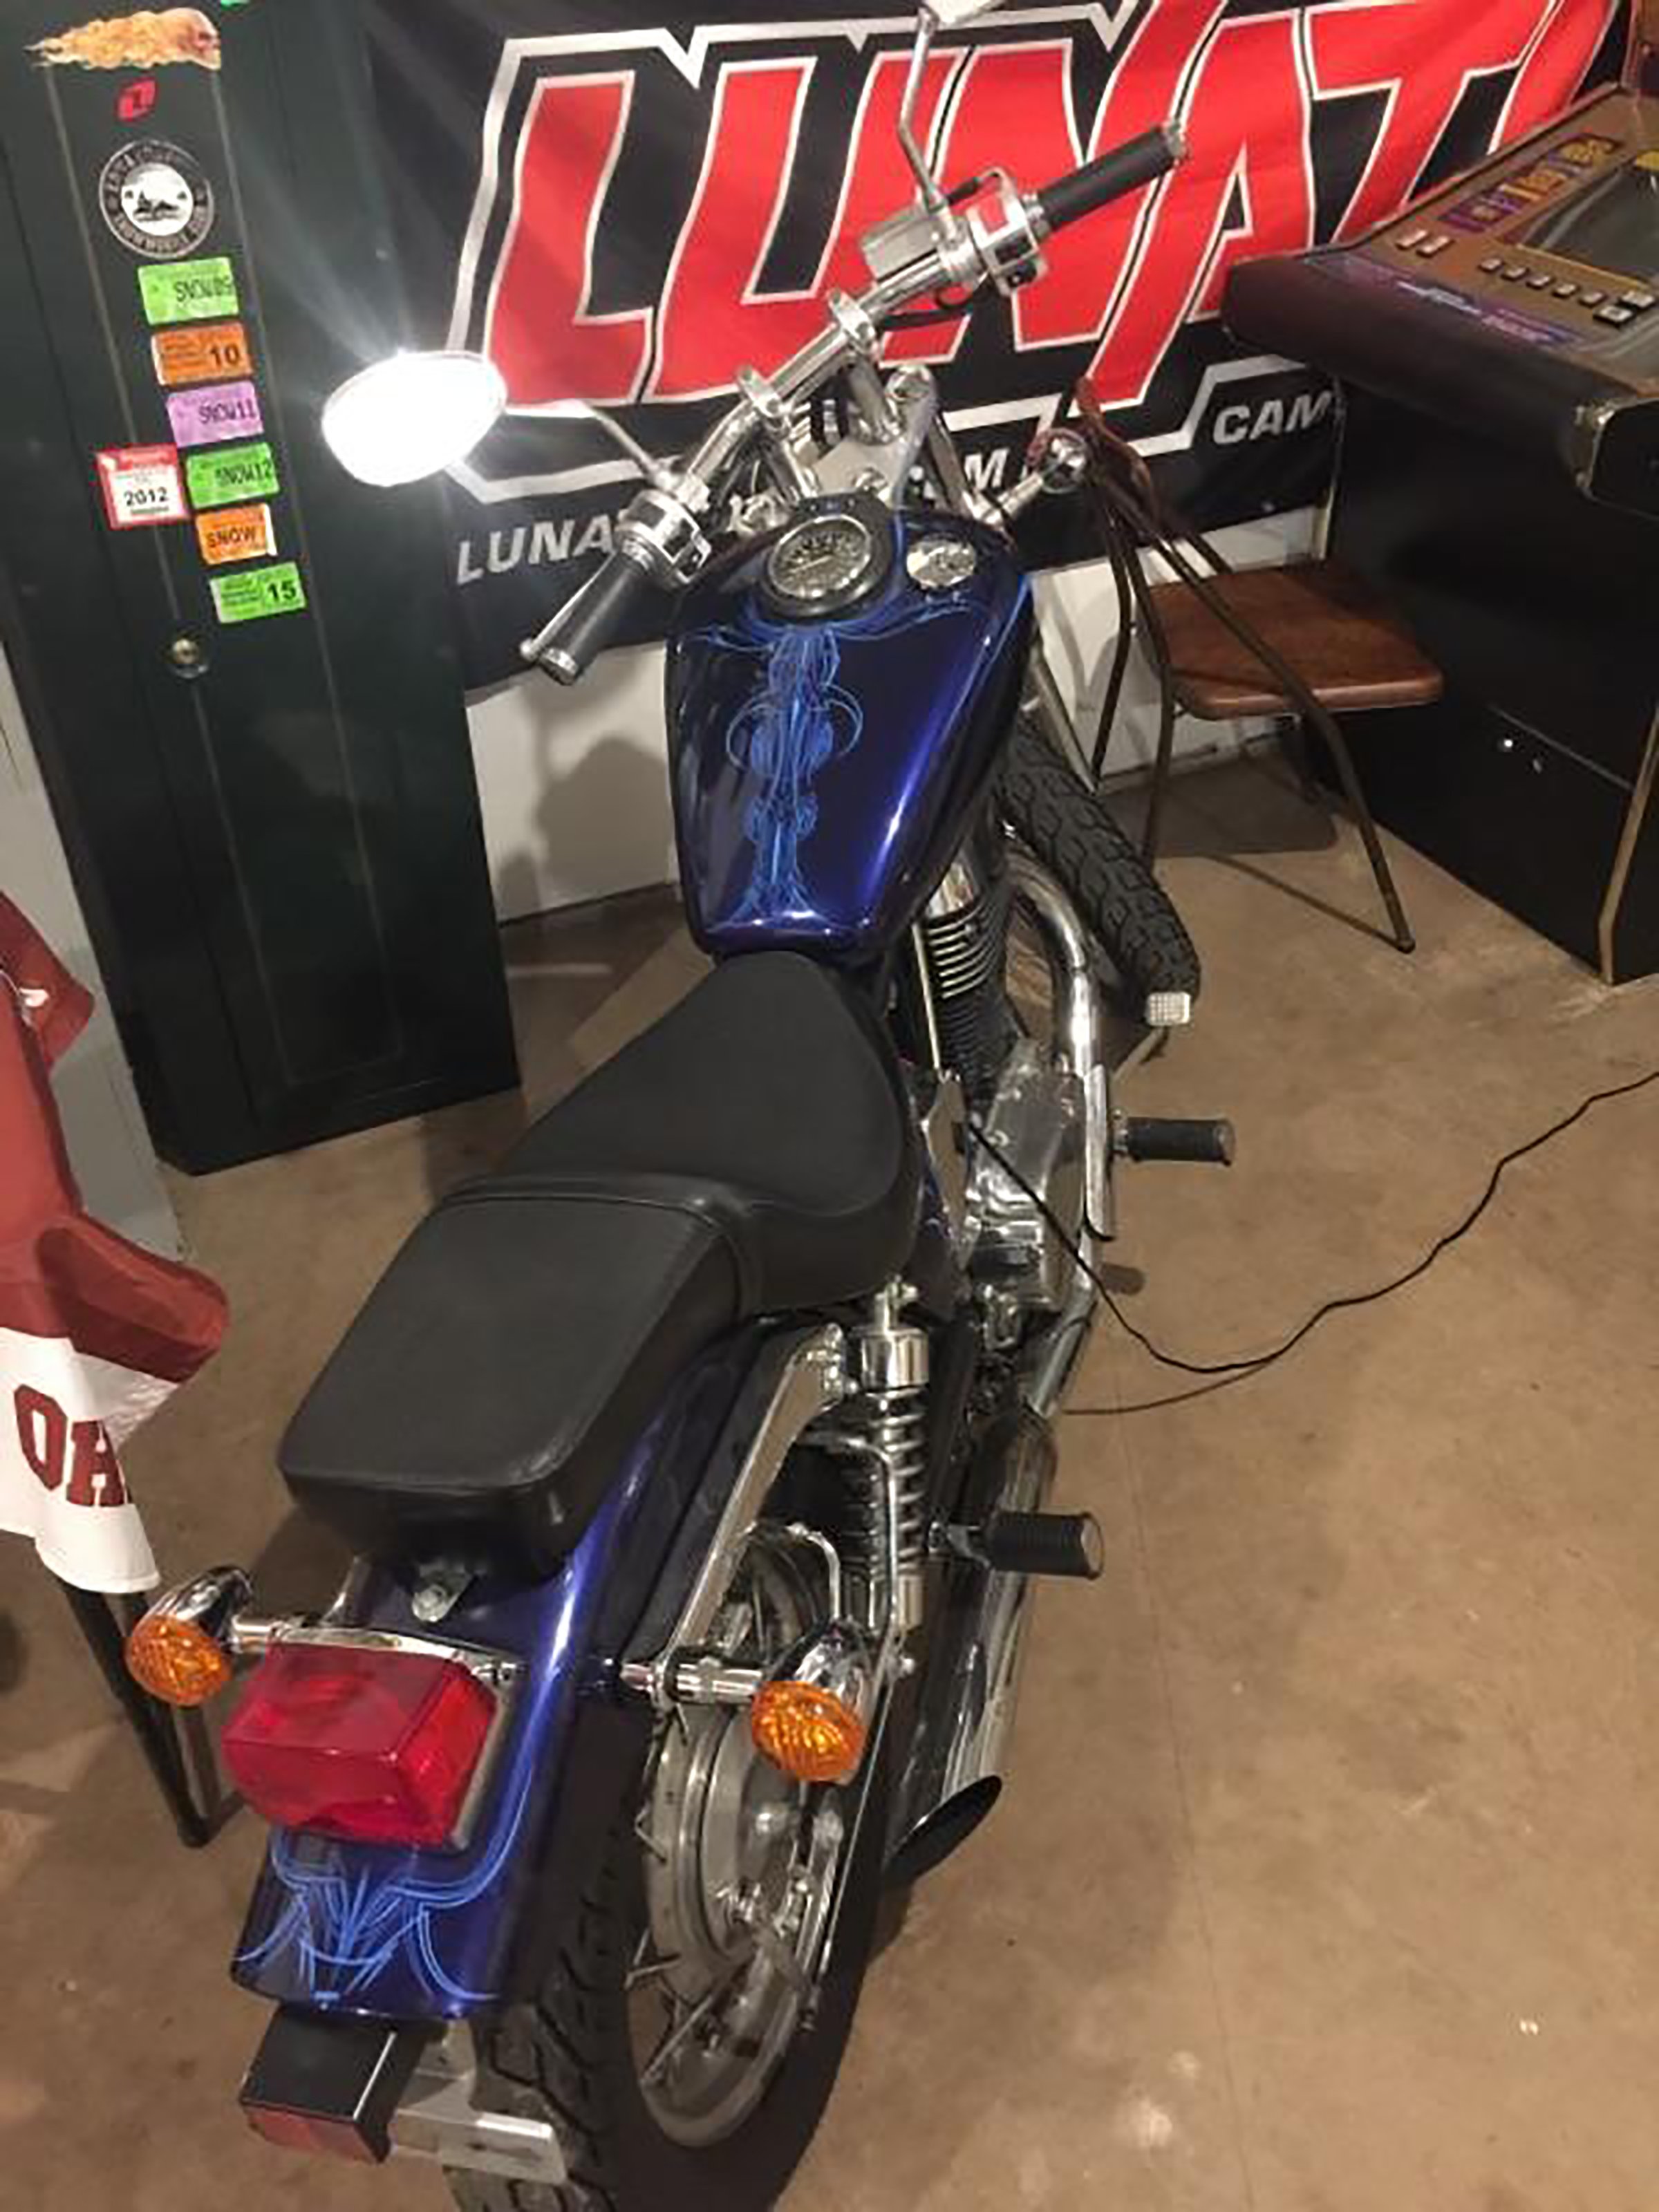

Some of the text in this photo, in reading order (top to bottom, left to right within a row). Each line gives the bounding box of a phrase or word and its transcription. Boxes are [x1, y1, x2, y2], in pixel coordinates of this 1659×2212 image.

[209, 342, 241, 368] 10
[123, 486, 169, 507] 2012
[457, 514, 614, 585] LUNA
[268, 579, 297, 601] 15
[14, 1384, 133, 1508] OH
